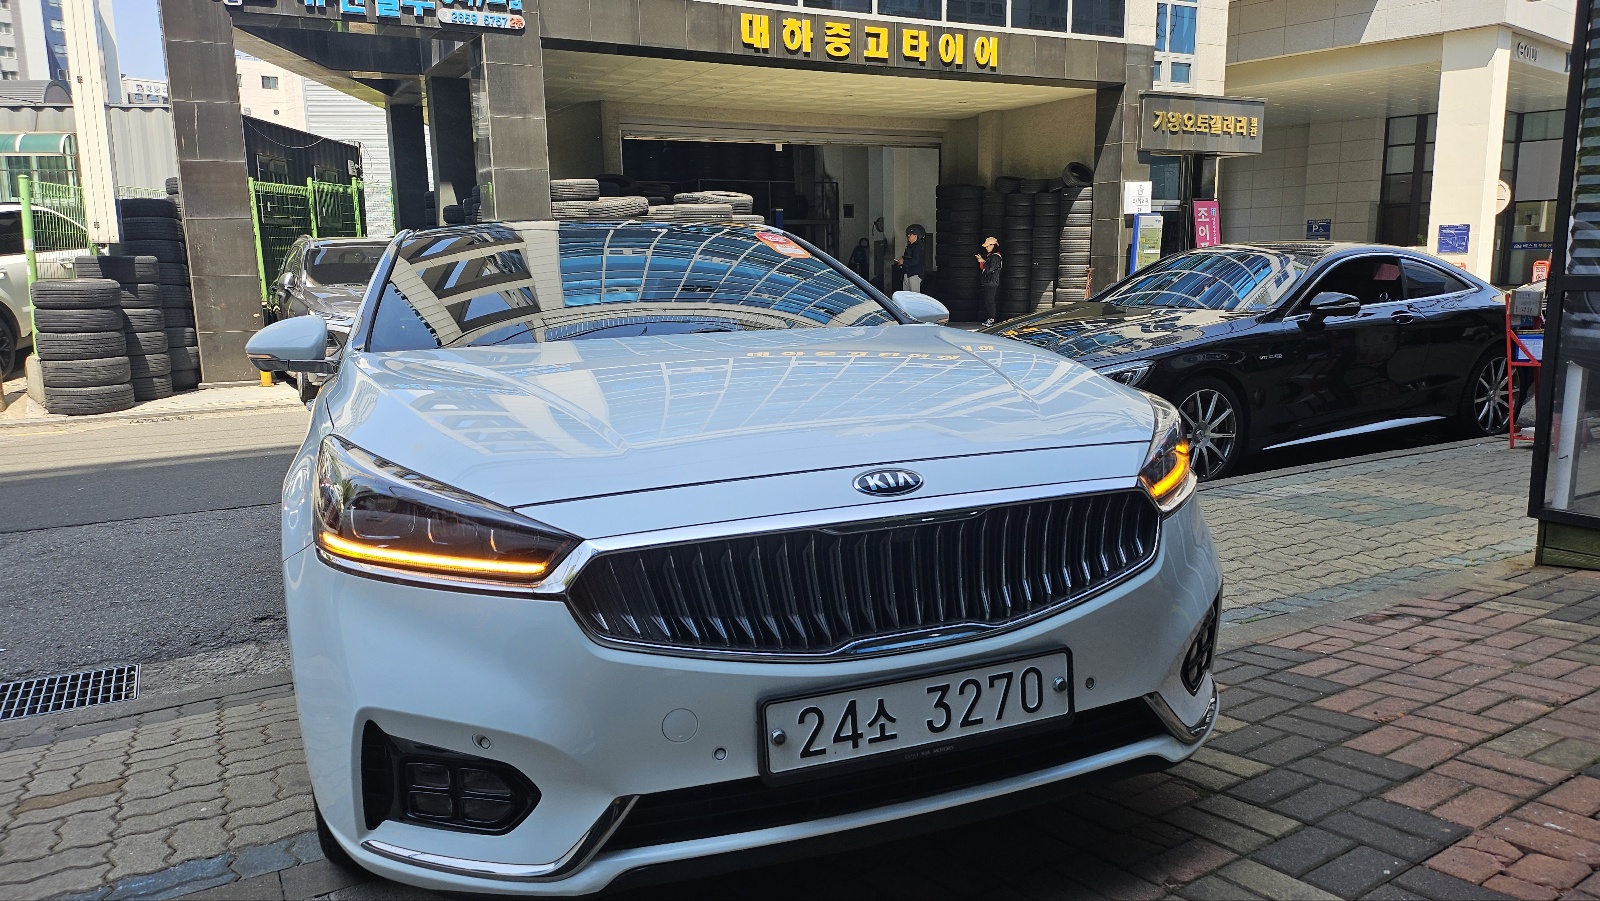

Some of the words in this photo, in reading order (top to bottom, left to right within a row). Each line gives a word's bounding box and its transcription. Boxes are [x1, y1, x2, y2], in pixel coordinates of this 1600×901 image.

[483, 14, 508, 27] 5757
[741, 13, 998, 67] 대하중고타이어
[1153, 111, 1247, 136] 가양오토갤러리
[863, 471, 916, 491] KIA
[797, 699, 898, 759] 24소
[926, 666, 1044, 733] 3270
